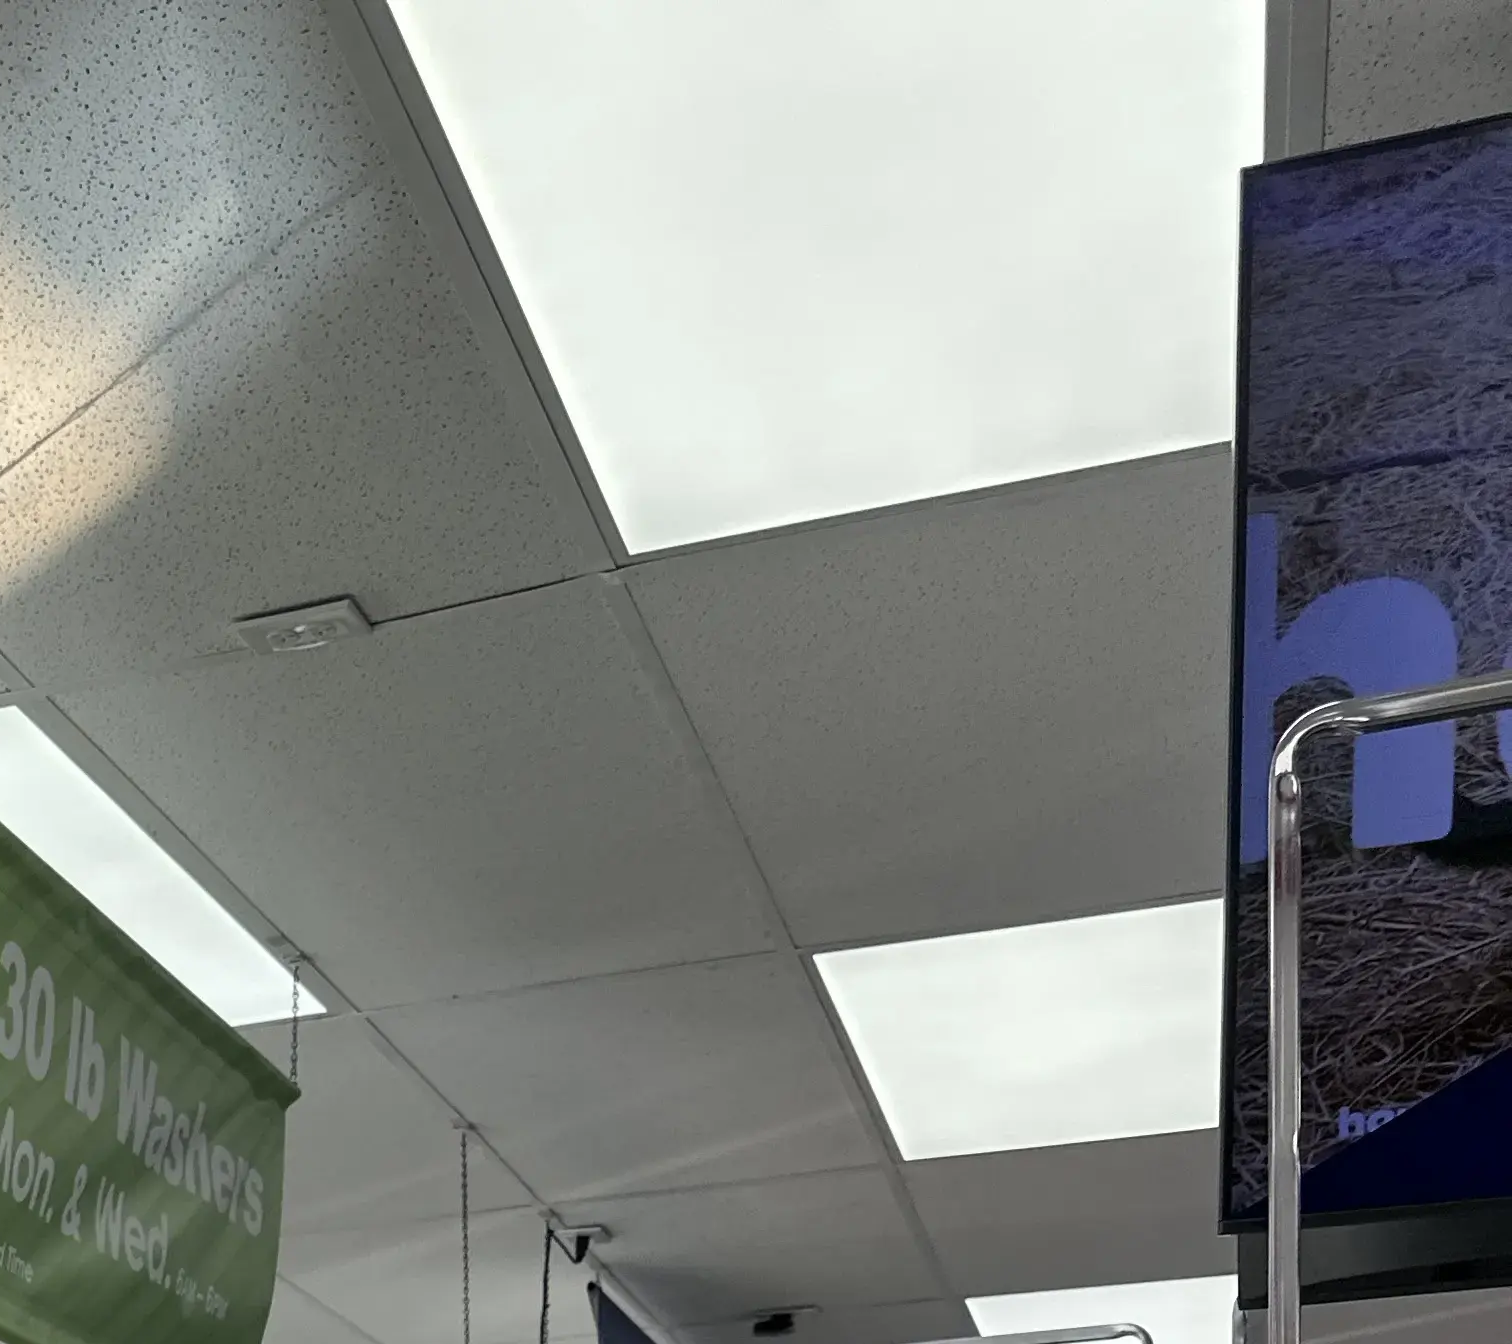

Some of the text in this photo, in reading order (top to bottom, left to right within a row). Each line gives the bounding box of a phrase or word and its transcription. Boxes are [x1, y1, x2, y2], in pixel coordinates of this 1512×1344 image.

[65, 997, 104, 1121] lb
[117, 1035, 263, 1236] Washers
[6, 1244, 34, 1284] Time
[61, 1164, 88, 1242] &
[96, 1177, 171, 1289] Wed.
